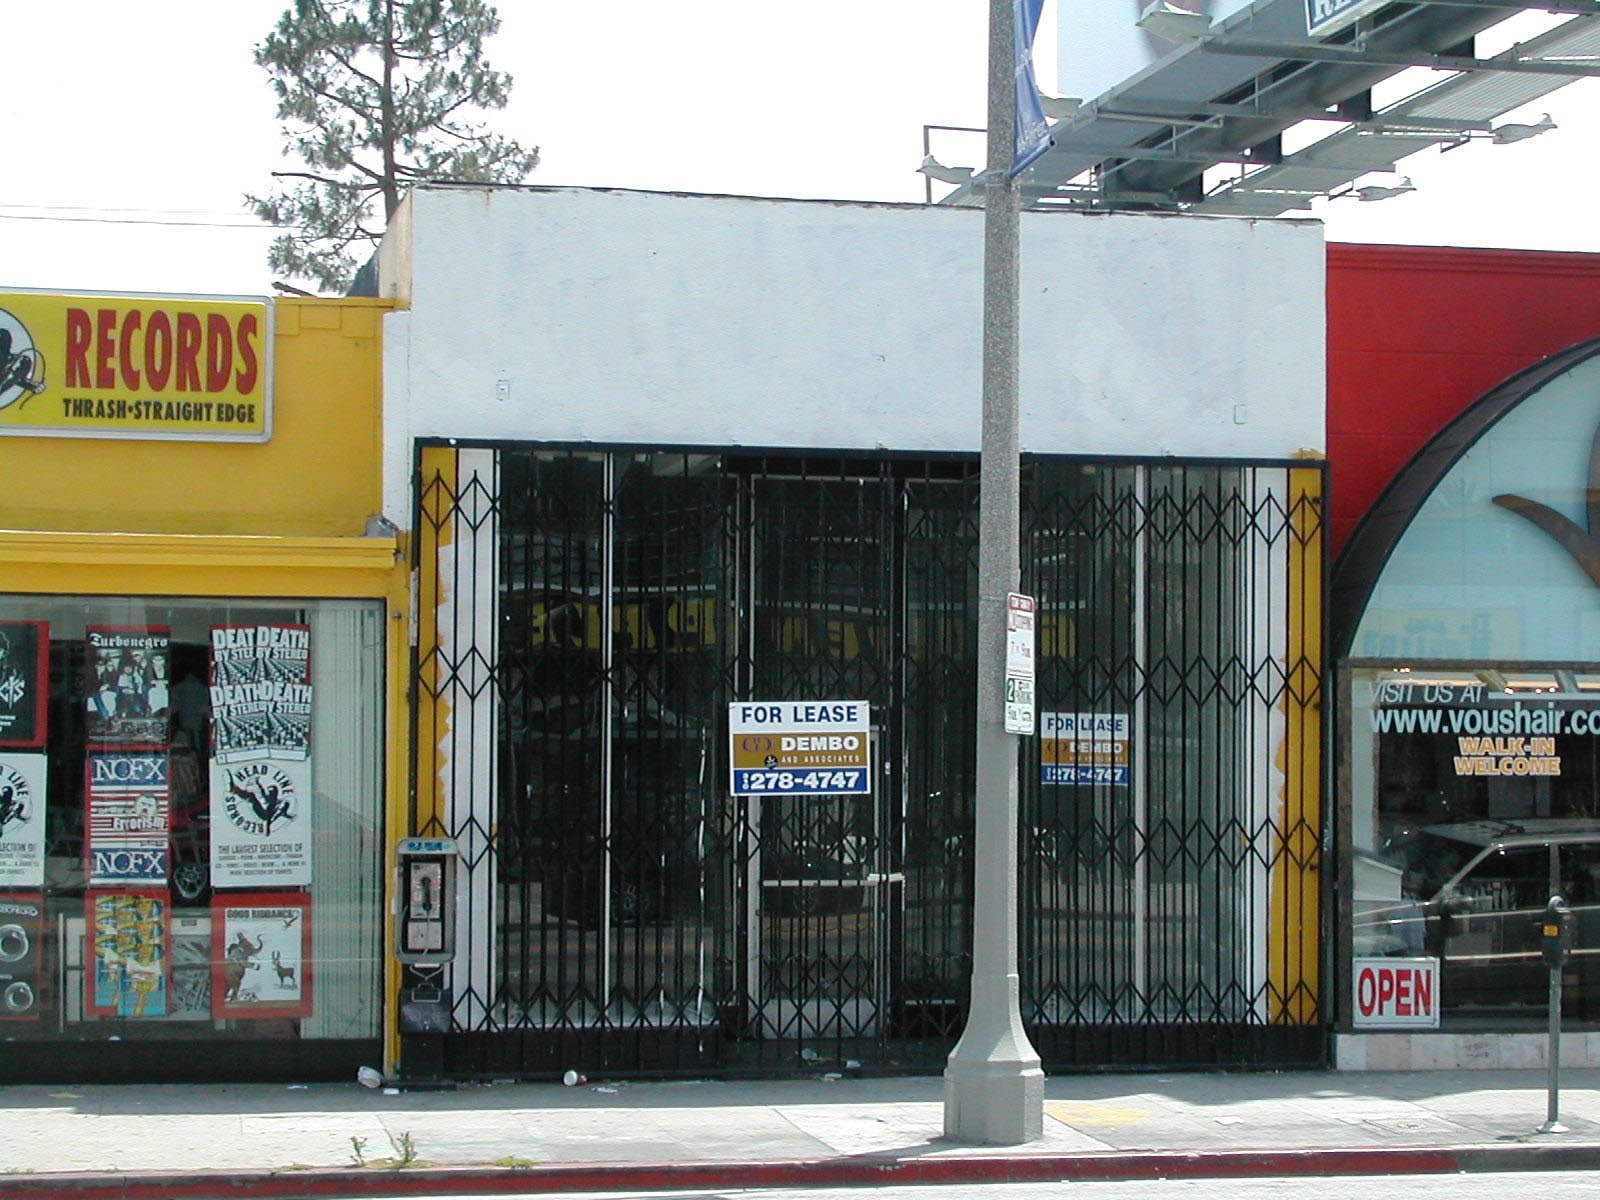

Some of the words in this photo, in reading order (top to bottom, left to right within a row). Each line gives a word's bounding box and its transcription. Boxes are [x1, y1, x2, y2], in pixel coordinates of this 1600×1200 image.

[65, 307, 258, 395] RECORDS
[216, 402, 255, 423] EDGE
[90, 633, 168, 649] Turbonegro
[212, 628, 256, 649] DEAT
[256, 626, 309, 649] DEATH
[214, 649, 229, 661] BY
[256, 647, 272, 660] BY
[272, 648, 308, 660] STEREO
[210, 682, 261, 707] DEATH
[260, 680, 312, 703] DEATH
[1369, 683, 1413, 703] VISIT
[1423, 684, 1454, 703] US
[1460, 684, 1484, 703] AT
[213, 705, 228, 718] BY
[276, 703, 311, 714] STEREO
[742, 706, 782, 723] FOR
[793, 705, 858, 723] LEASE
[1047, 717, 1074, 731] FOR
[1081, 718, 1123, 731] LEASE
[781, 736, 860, 751] DEMBO
[1458, 737, 1555, 756] WALK-IN
[781, 755, 798, 764] AND
[804, 755, 860, 764] ASSOCIATES
[1453, 757, 1561, 776] WELCOME
[94, 758, 165, 781] NOFX
[235, 764, 268, 782] HEAD
[273, 771, 293, 795] LINE
[750, 771, 860, 790] 278-4747
[226, 796, 264, 833] RECORDS
[94, 851, 165, 874] NOFX
[1358, 967, 1432, 1017] OPEN
